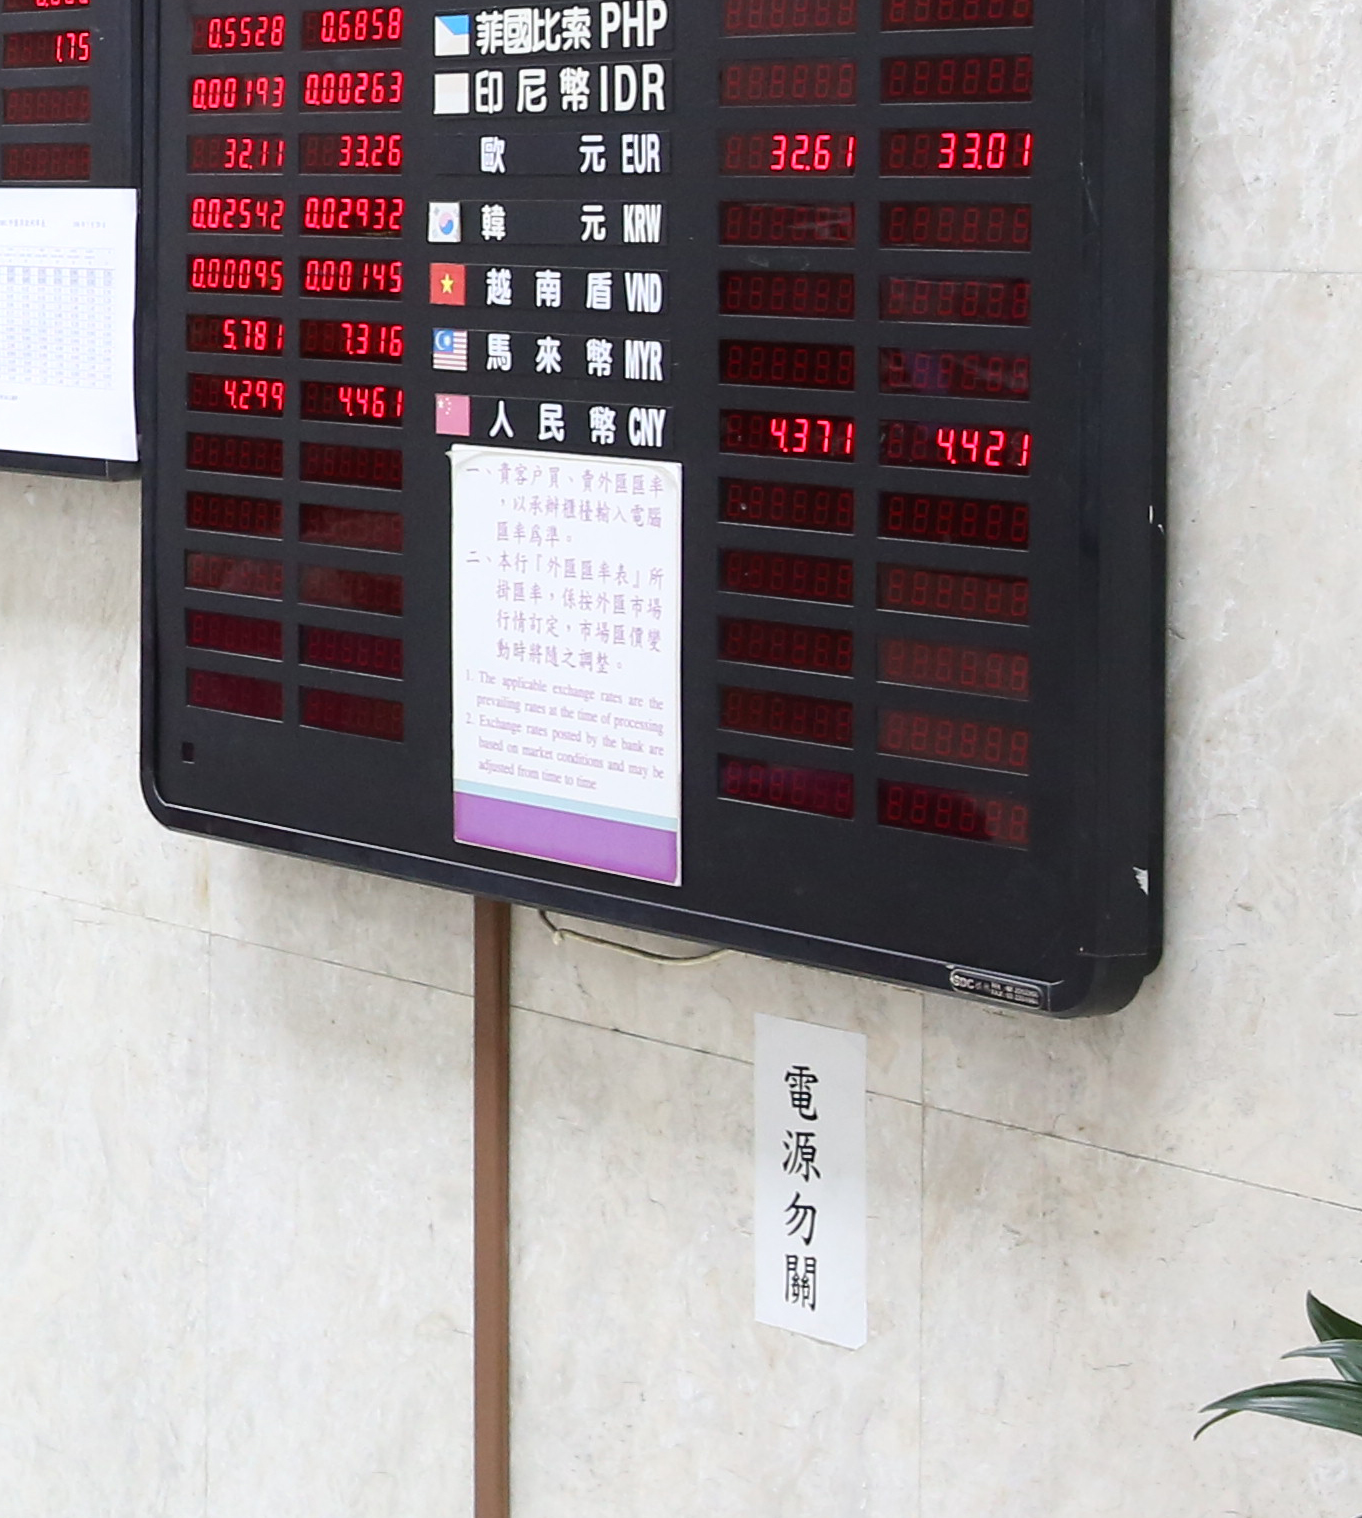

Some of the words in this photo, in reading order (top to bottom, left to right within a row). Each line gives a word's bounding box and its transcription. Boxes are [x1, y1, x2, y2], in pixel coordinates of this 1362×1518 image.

[475, 5, 592, 55] 菲國比索
[475, 66, 592, 114] 印尼幣
[600, 62, 666, 113] IDR
[621, 133, 662, 174] EUR
[622, 203, 663, 243] KRW
[486, 267, 613, 311] 越南盾
[624, 271, 663, 313] VND
[486, 332, 614, 378] 馬來幣
[624, 339, 664, 382] MYR
[488, 398, 617, 446] 人民幣
[628, 406, 667, 448] CNY
[552, 684, 596, 702] exchange
[781, 1064, 822, 1313] 電源勿關
